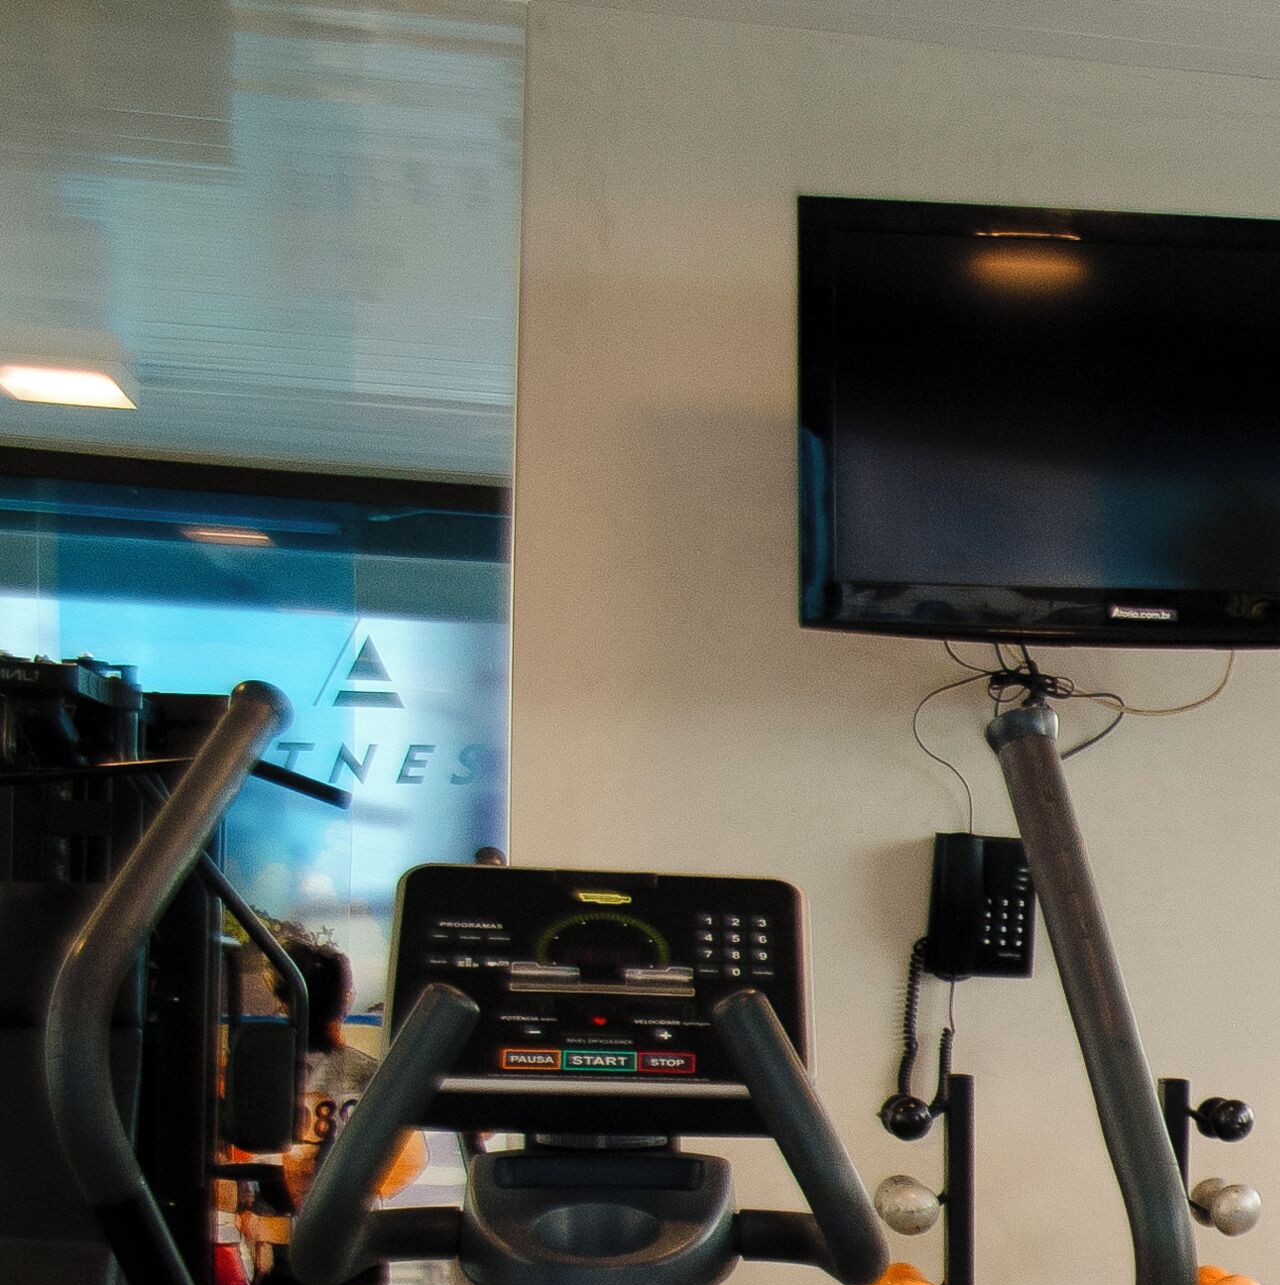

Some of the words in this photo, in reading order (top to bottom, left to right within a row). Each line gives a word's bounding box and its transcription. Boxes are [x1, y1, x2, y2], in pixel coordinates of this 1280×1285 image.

[704, 917, 712, 925] 1
[732, 918, 740, 927] 2
[758, 918, 767, 928] 3
[704, 933, 713, 942] 4
[732, 934, 740, 943] 5
[759, 935, 768, 944] 6
[704, 949, 713, 959] 7
[732, 951, 741, 960] 8
[759, 952, 768, 961] 9
[732, 967, 741, 977] 0
[509, 1054, 555, 1065] PAUSA
[571, 1055, 629, 1067] START
[650, 1057, 686, 1067] STOP
